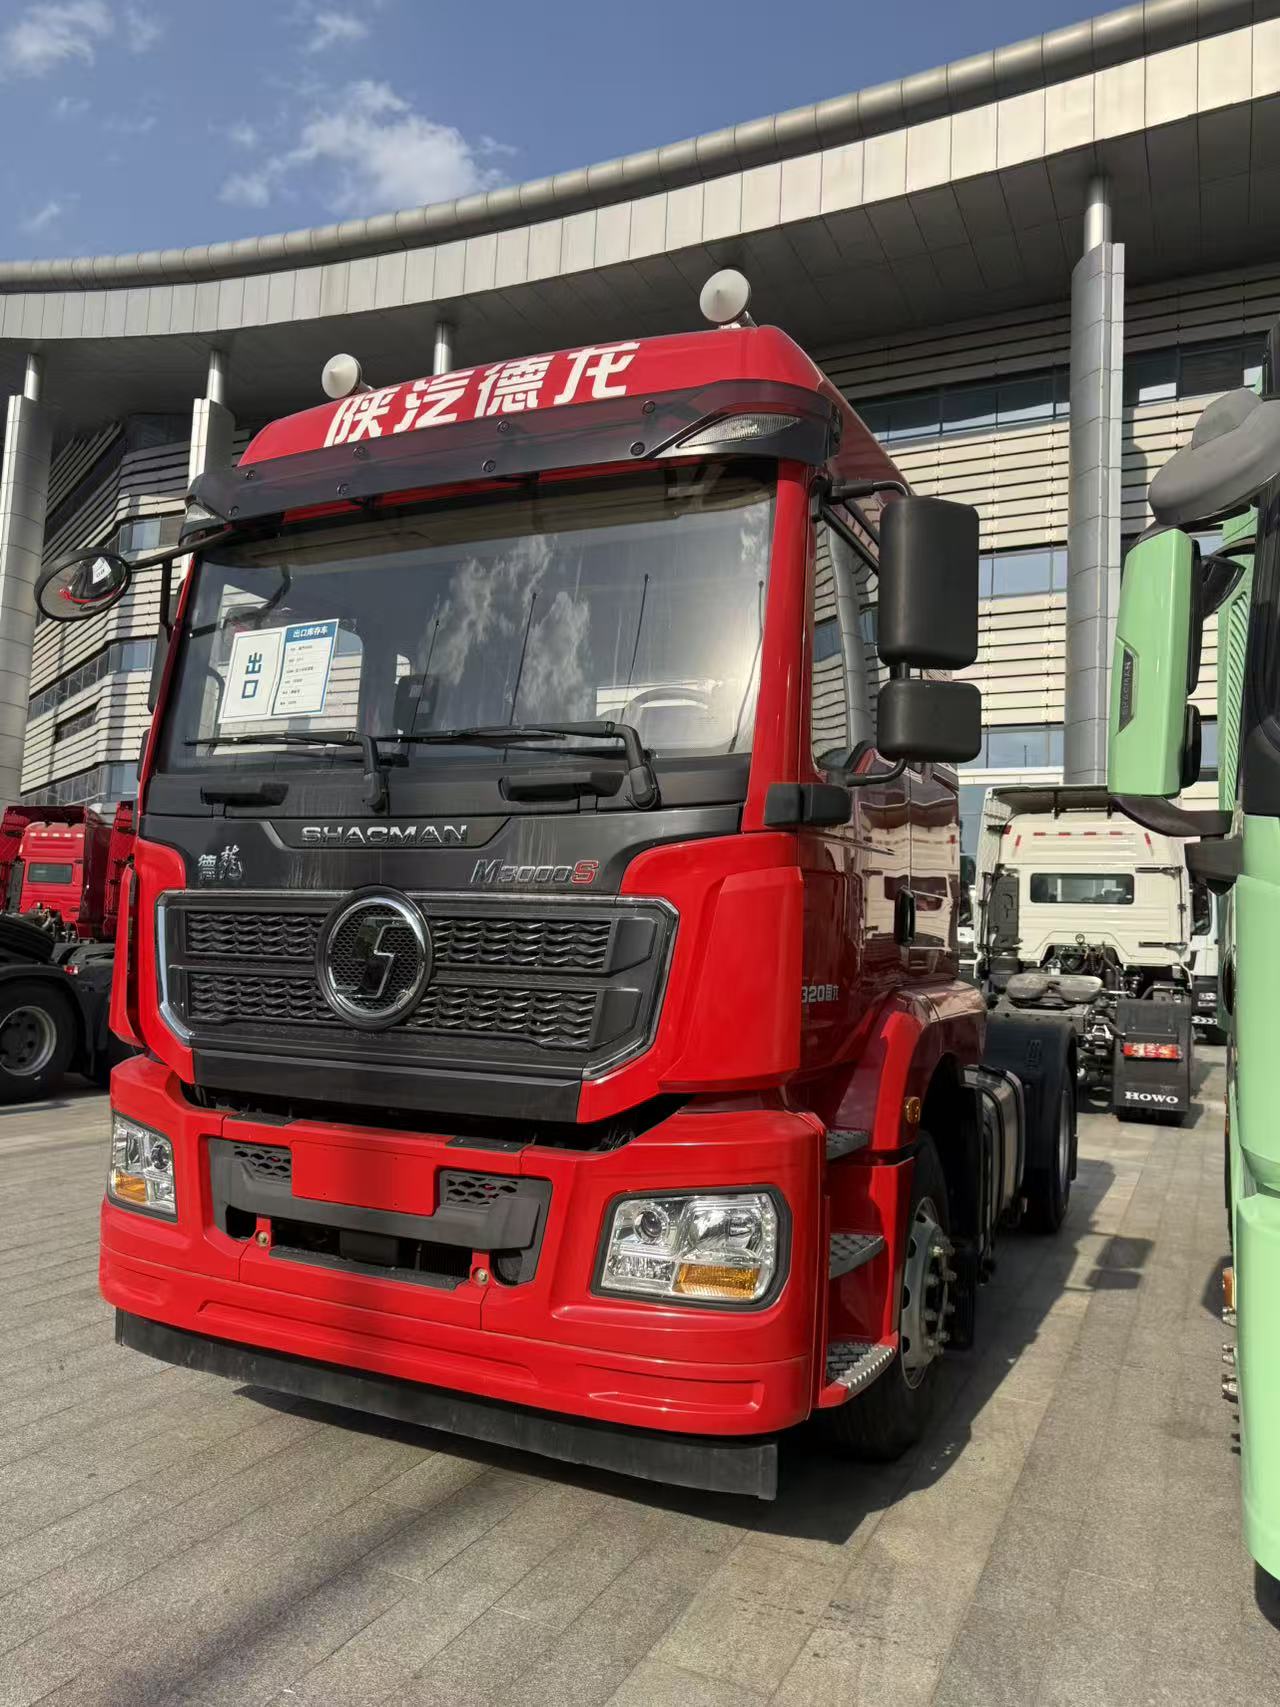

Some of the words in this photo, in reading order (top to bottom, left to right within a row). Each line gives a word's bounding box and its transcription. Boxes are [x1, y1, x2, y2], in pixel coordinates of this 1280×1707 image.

[323, 342, 640, 448] 陕汽德龙
[293, 625, 328, 638] 出口库存车
[241, 652, 262, 699] 出口
[301, 825, 468, 844] SHACMAN
[470, 859, 599, 884] M3000S
[1124, 1091, 1179, 1104] HOWO
